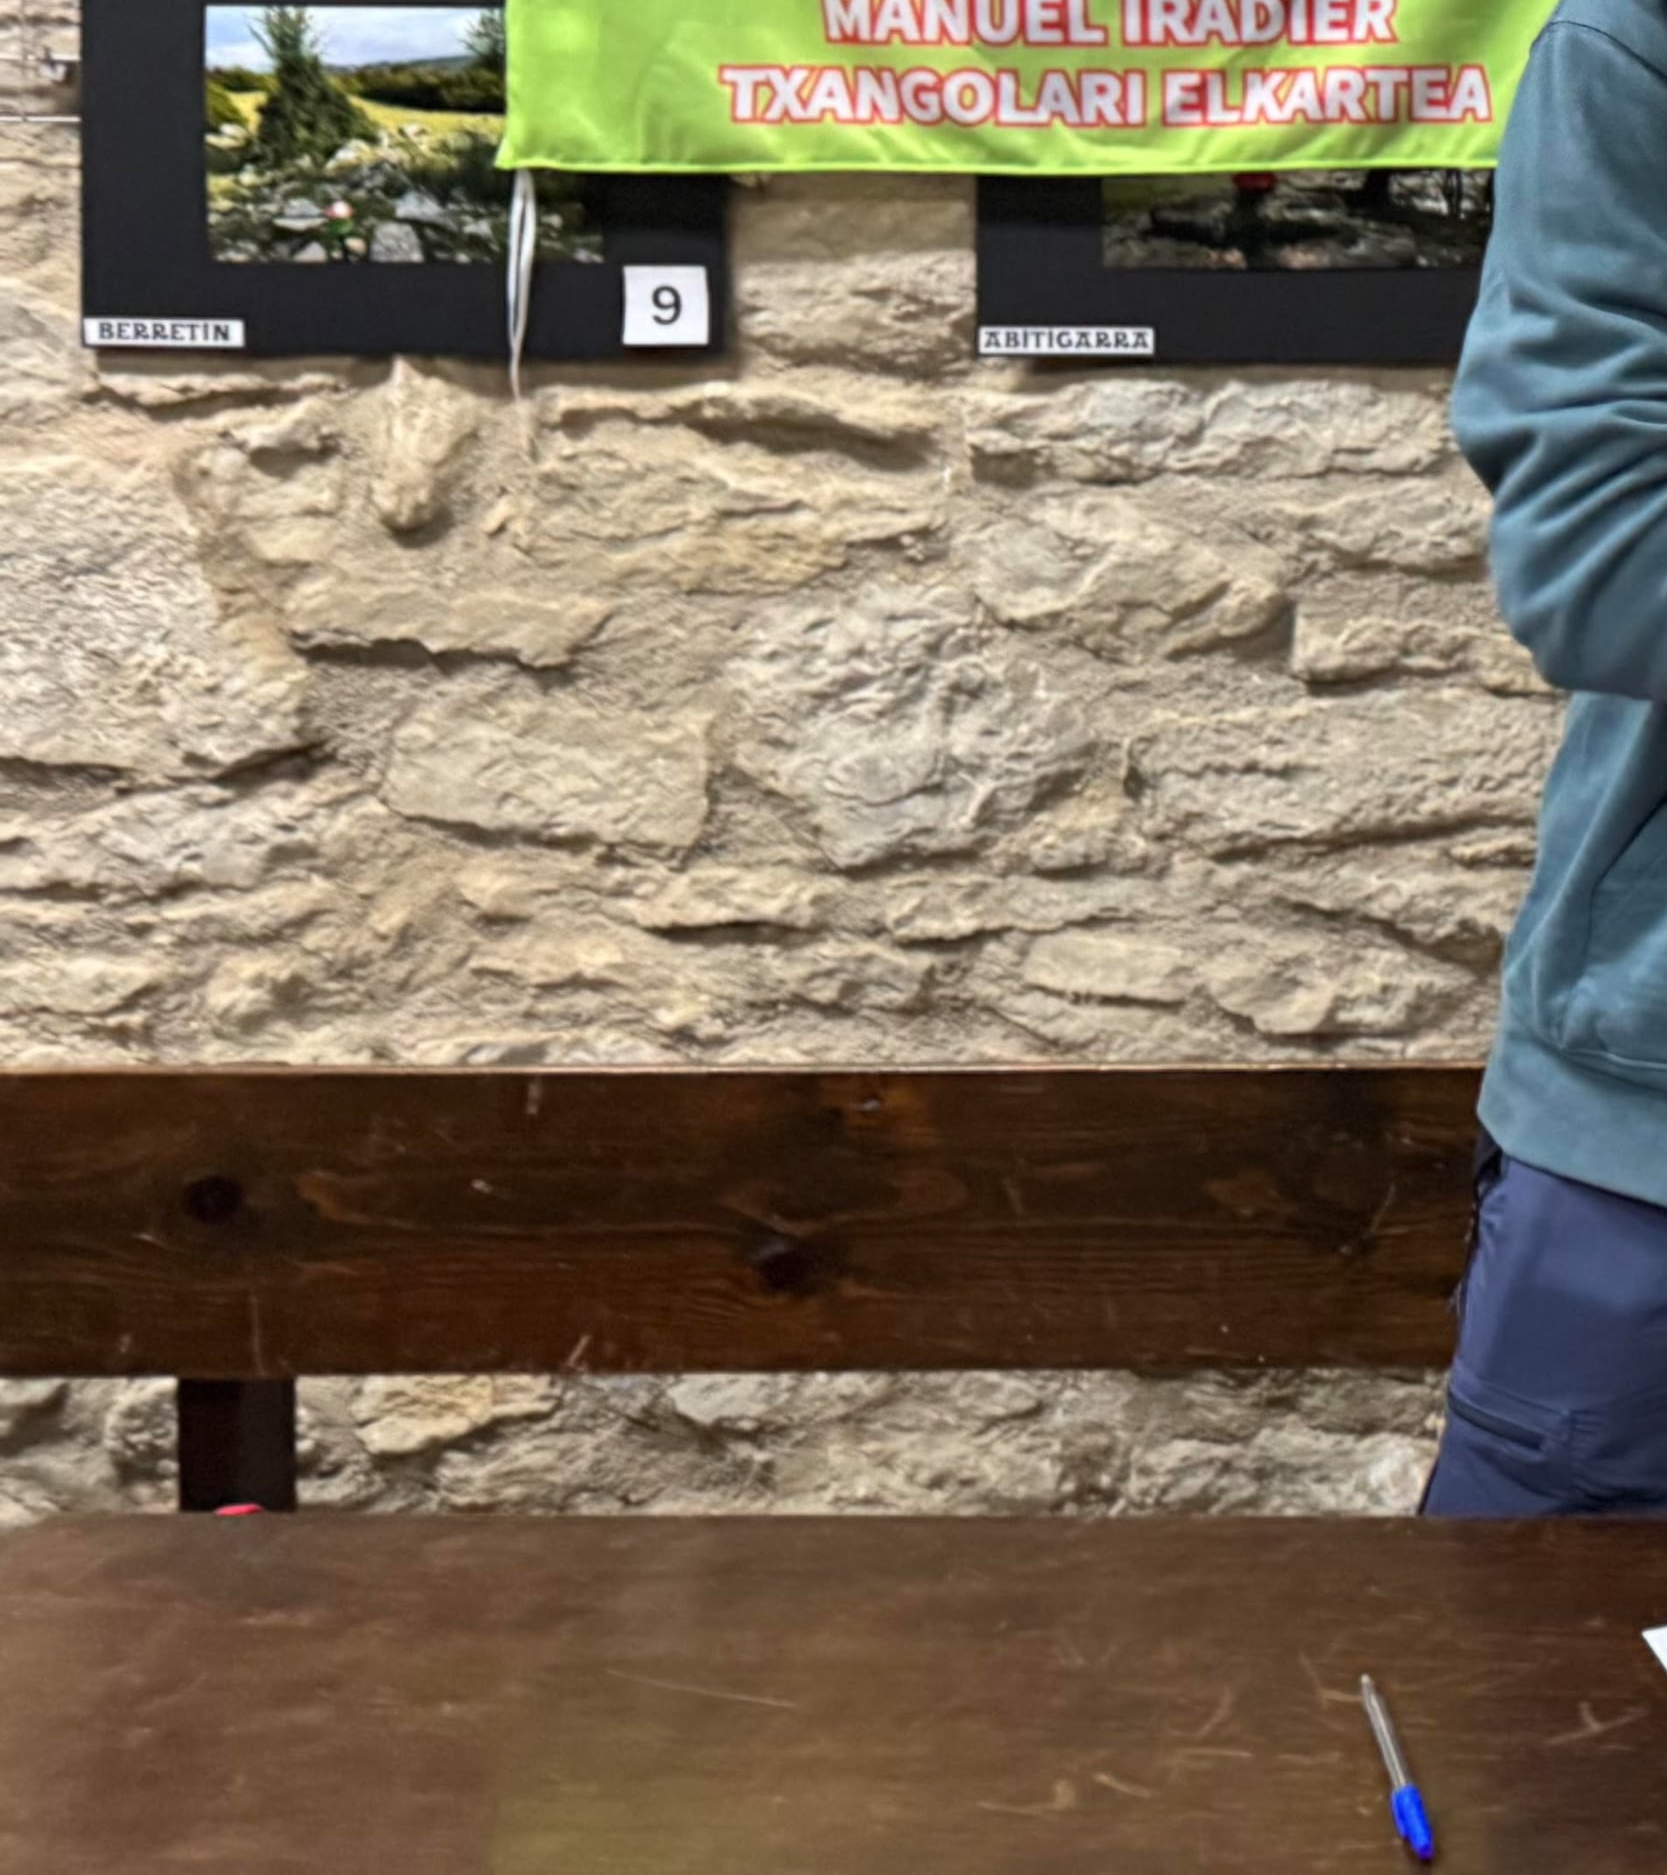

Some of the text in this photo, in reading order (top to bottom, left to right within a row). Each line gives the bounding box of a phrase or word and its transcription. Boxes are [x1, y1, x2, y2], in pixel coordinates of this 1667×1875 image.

[719, 63, 1494, 126] TXANGOLARI ELKARTEA
[651, 286, 682, 325] 9
[99, 321, 232, 343] BERRETIN
[984, 327, 1151, 350] ABITIGARRA
